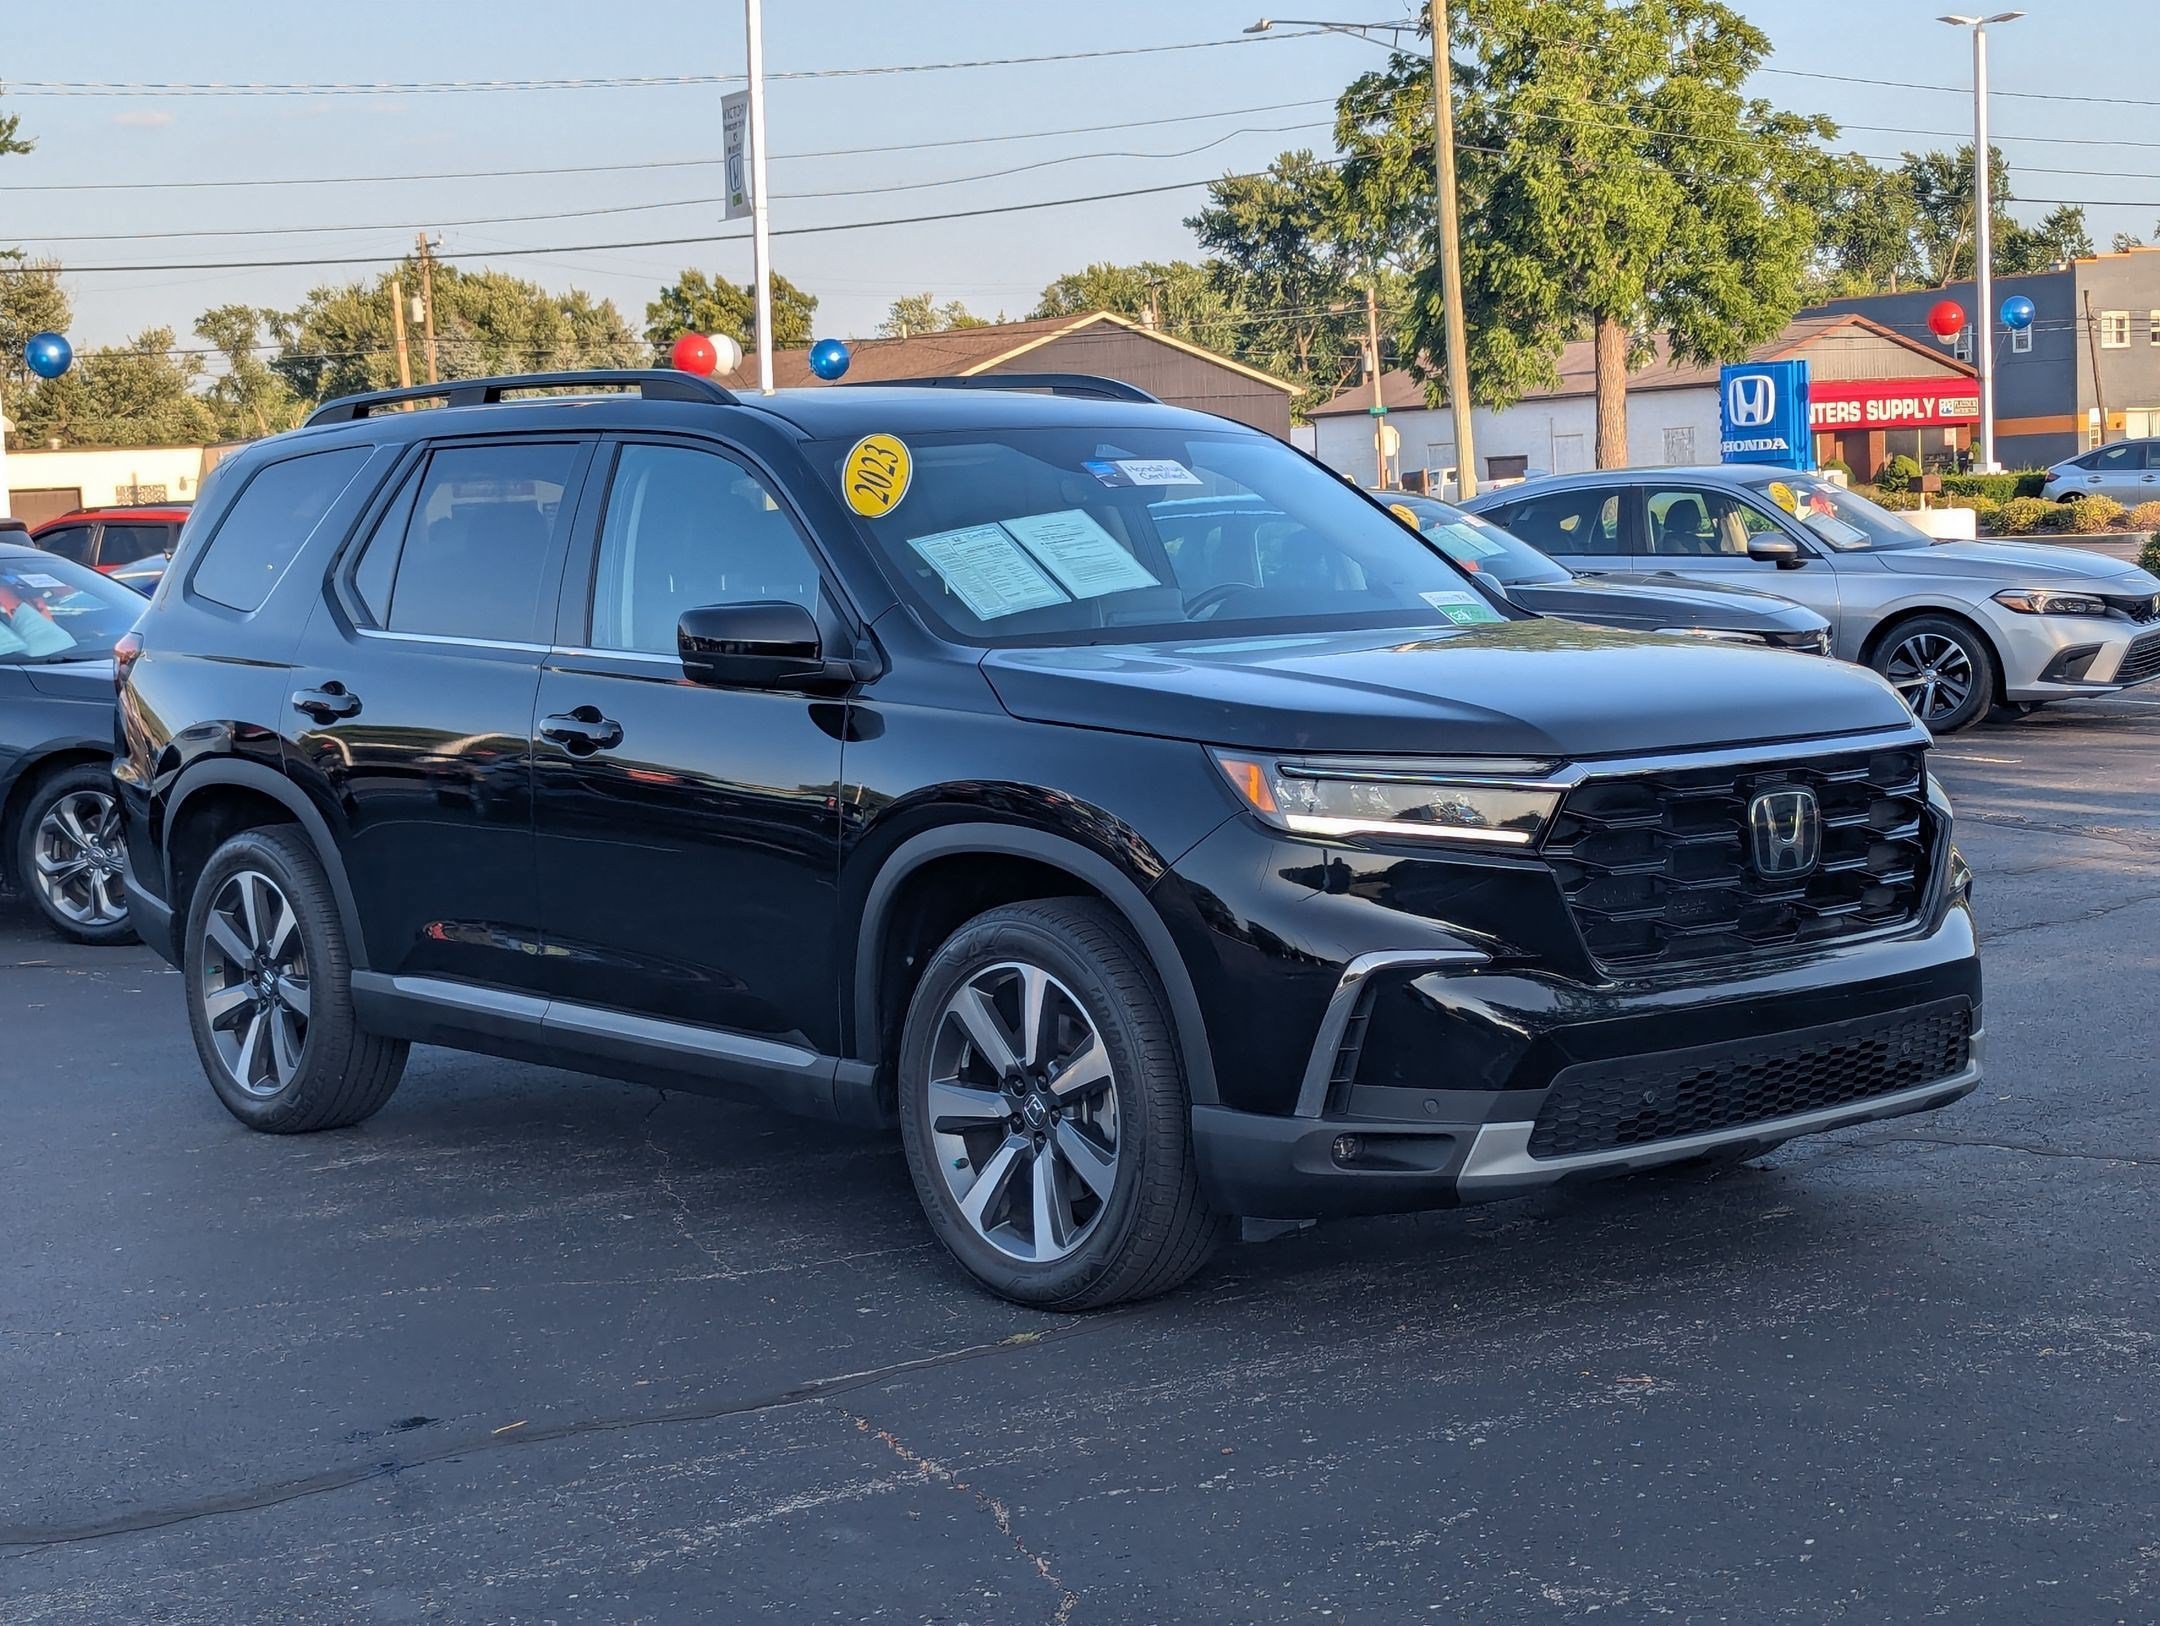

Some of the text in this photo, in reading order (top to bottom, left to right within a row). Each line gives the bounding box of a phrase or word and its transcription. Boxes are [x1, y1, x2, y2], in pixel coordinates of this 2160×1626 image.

[1866, 397, 1936, 421] SUPPLY
[1722, 438, 1789, 453] HONDA
[854, 444, 899, 505] 2023
